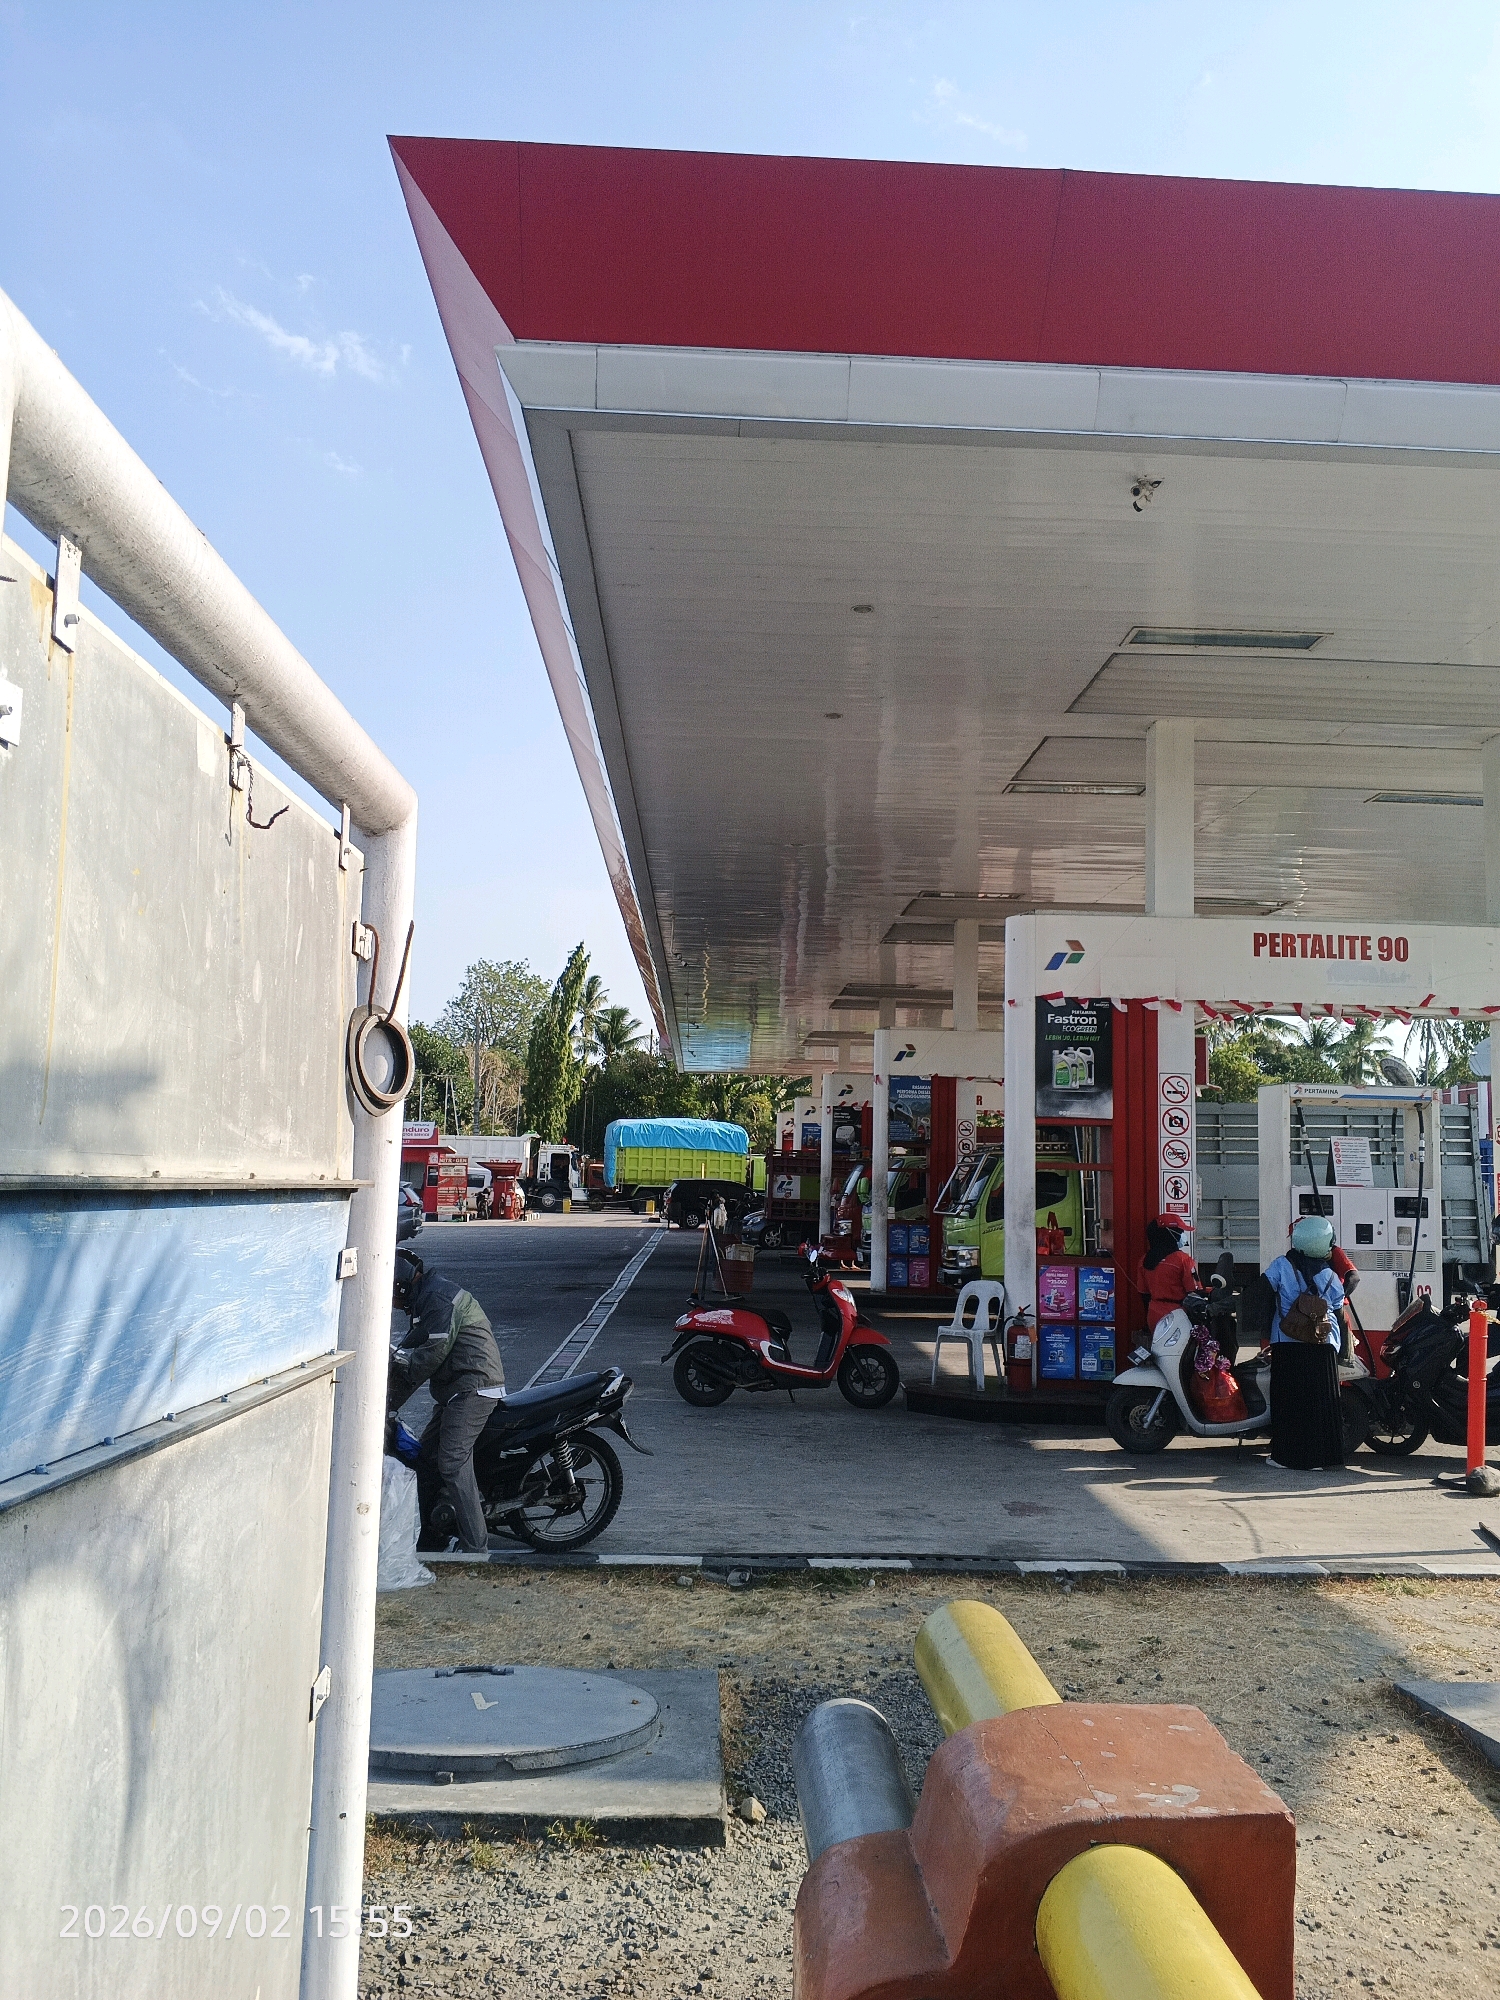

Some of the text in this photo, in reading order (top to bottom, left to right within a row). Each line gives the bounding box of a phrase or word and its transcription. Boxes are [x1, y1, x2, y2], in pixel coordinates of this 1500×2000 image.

[1253, 932, 1409, 962] PERTALITE 90
[1047, 1013, 1097, 1024] Fastron
